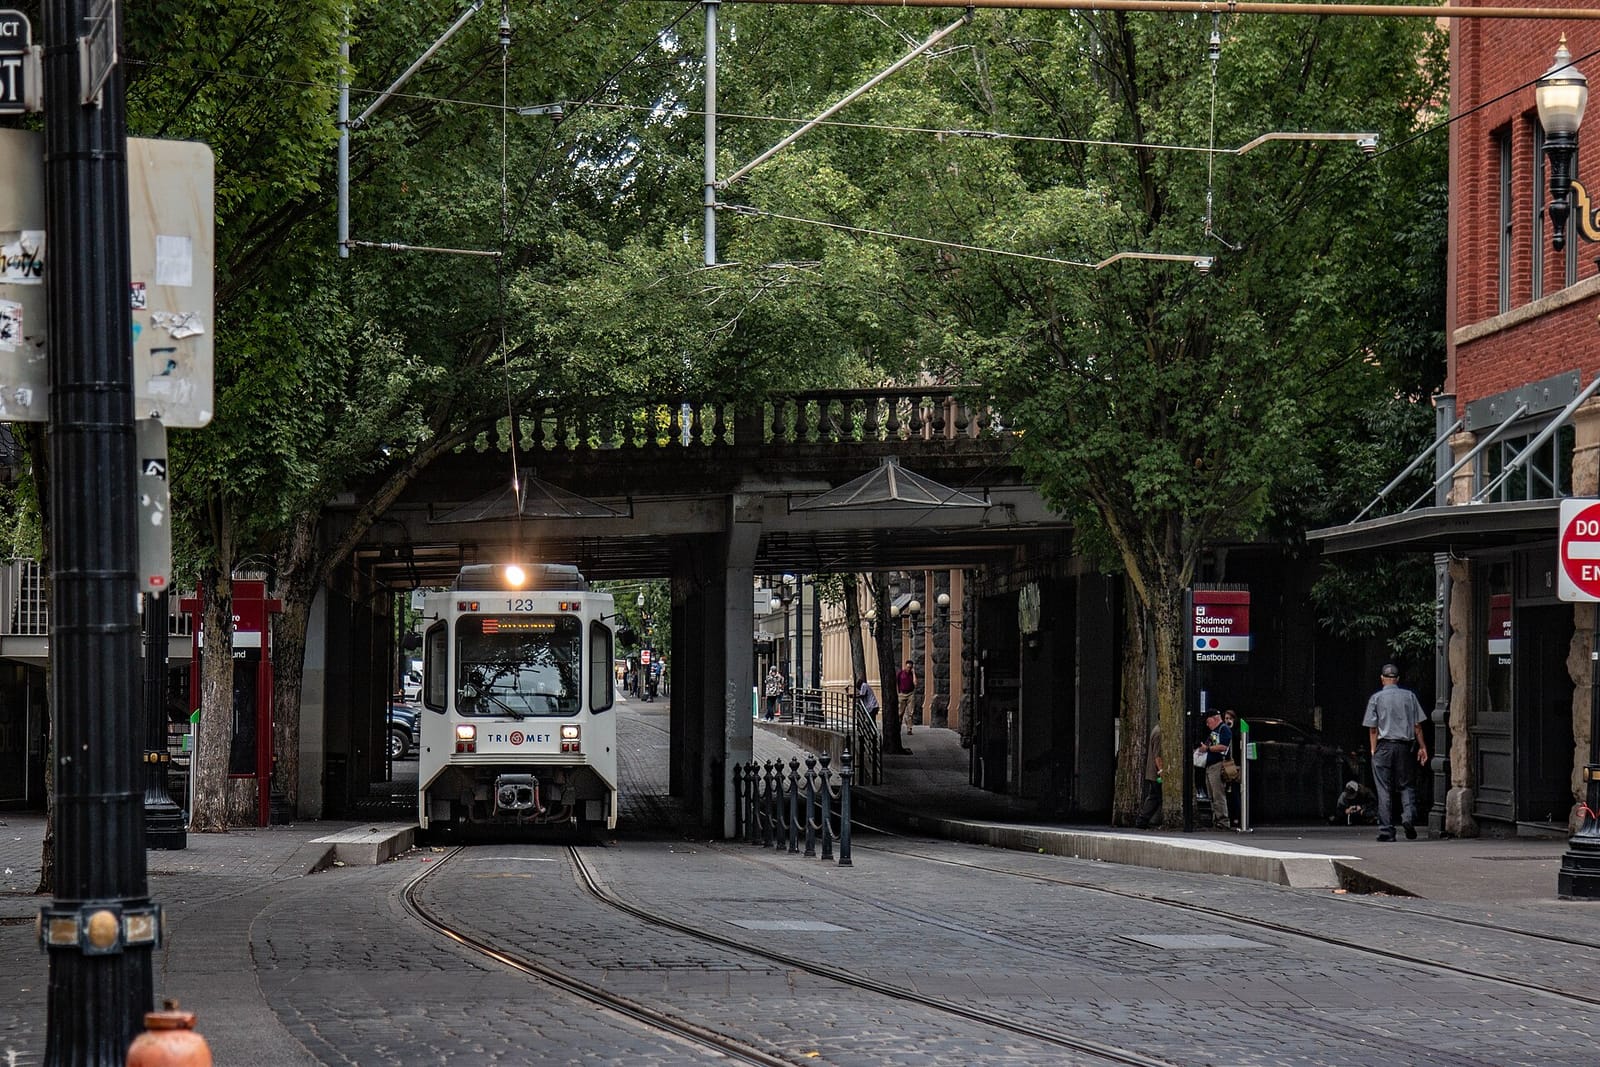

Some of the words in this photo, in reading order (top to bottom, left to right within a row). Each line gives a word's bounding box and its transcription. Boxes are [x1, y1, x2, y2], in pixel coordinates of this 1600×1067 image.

[1576, 519, 1600, 537] DO
[505, 598, 534, 612] 123
[1195, 616, 1234, 625] Skidmore
[1195, 625, 1231, 634] Fountain
[1195, 653, 1236, 662] Eastbound
[487, 733, 509, 744] TRI
[525, 733, 551, 744] MET
